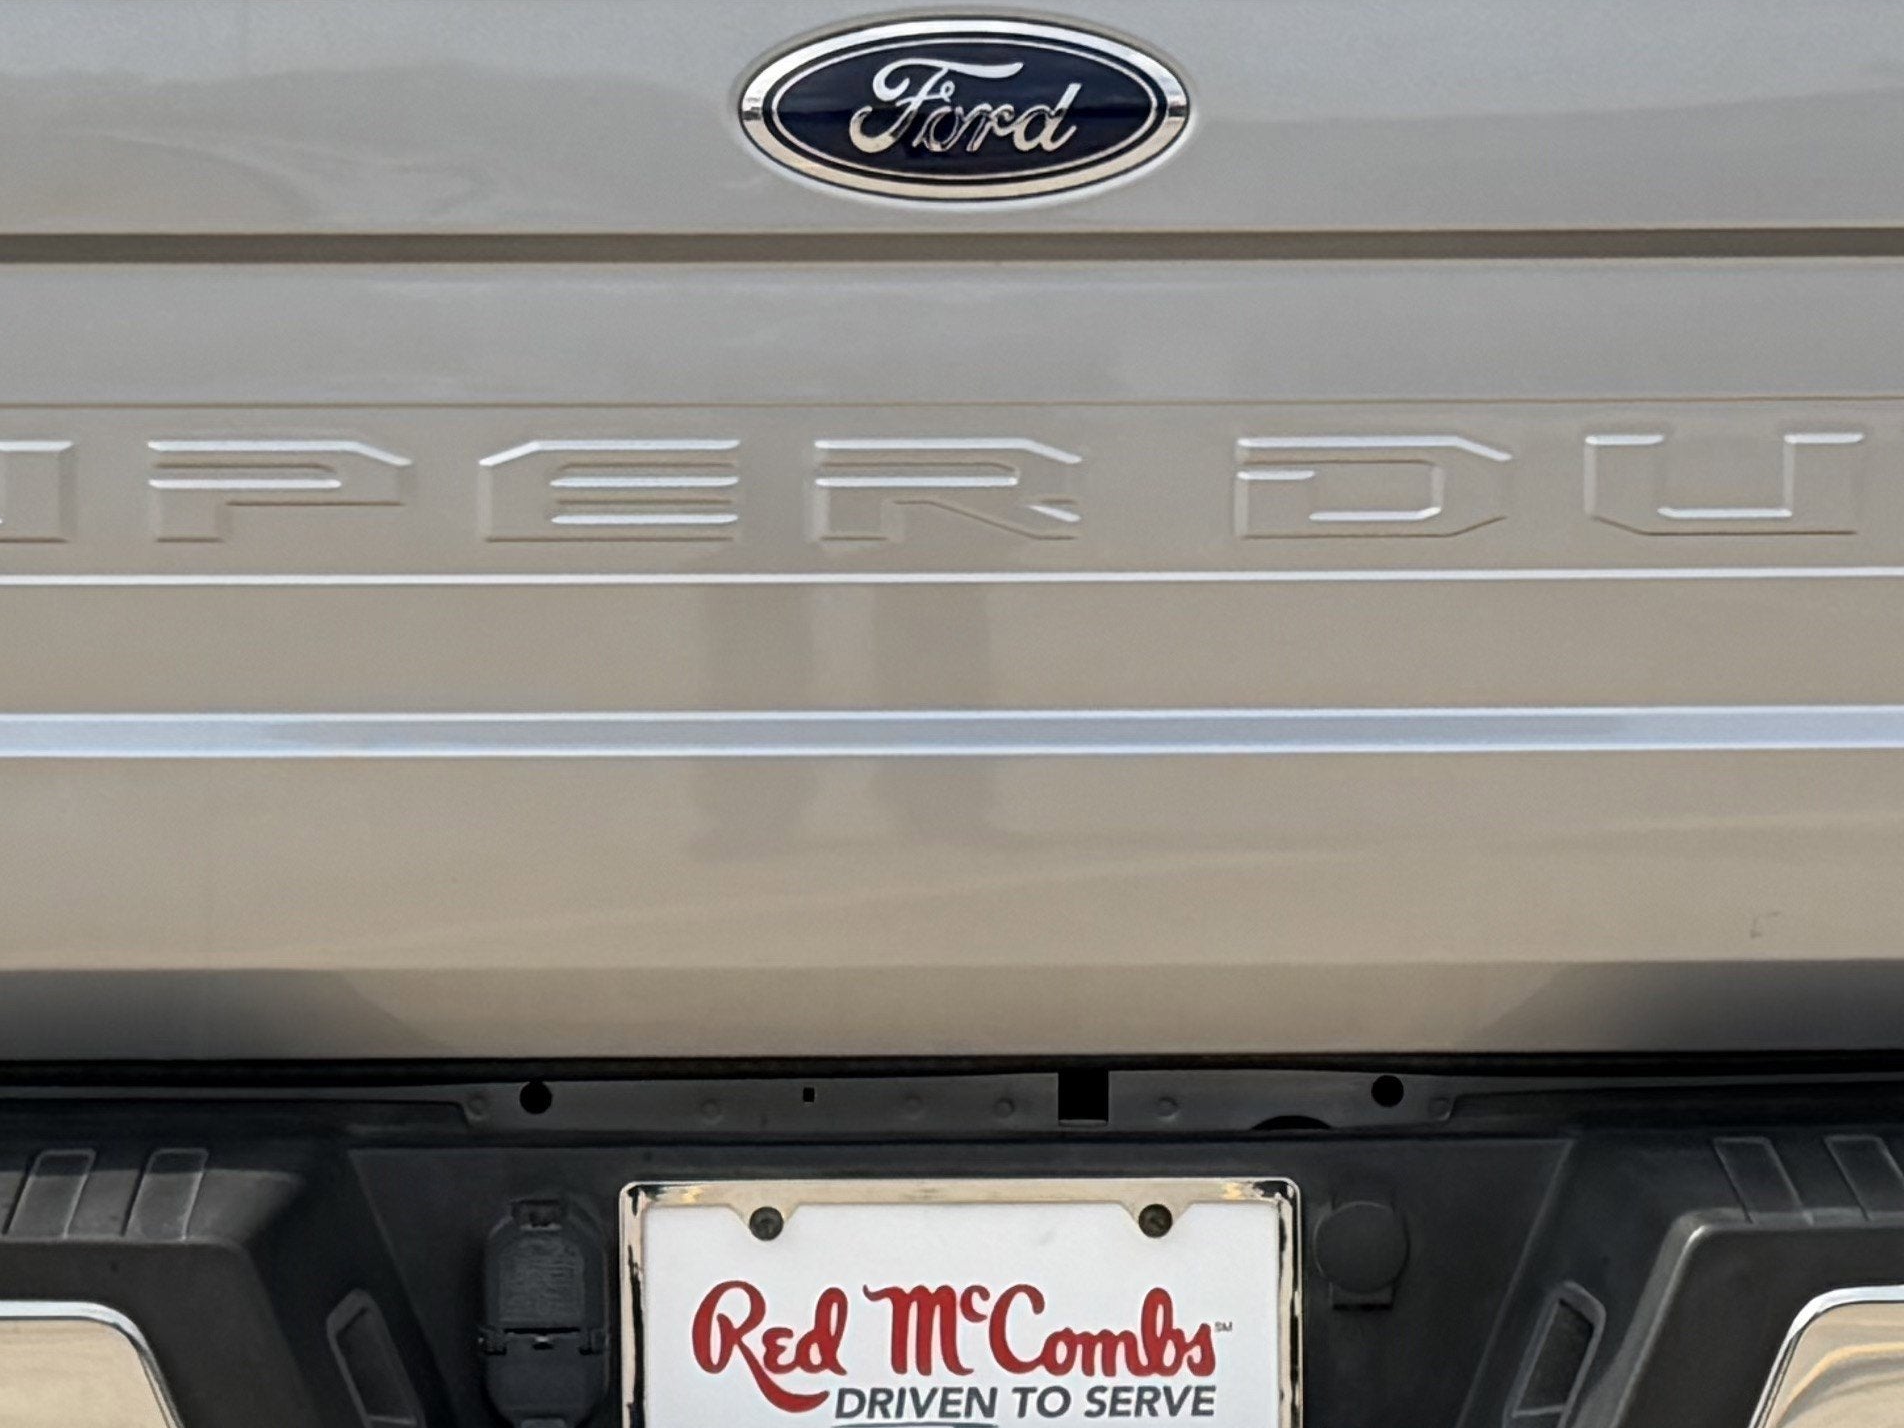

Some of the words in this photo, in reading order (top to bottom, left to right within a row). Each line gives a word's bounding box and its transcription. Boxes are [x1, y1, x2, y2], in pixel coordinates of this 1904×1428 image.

[849, 58, 1082, 153] Ford
[692, 1280, 848, 1412] Red
[862, 1283, 1217, 1377] McCombs
[835, 1387, 999, 1420] DRIVEN
[1011, 1386, 1073, 1418] TO
[1083, 1385, 1216, 1418] SERVE
